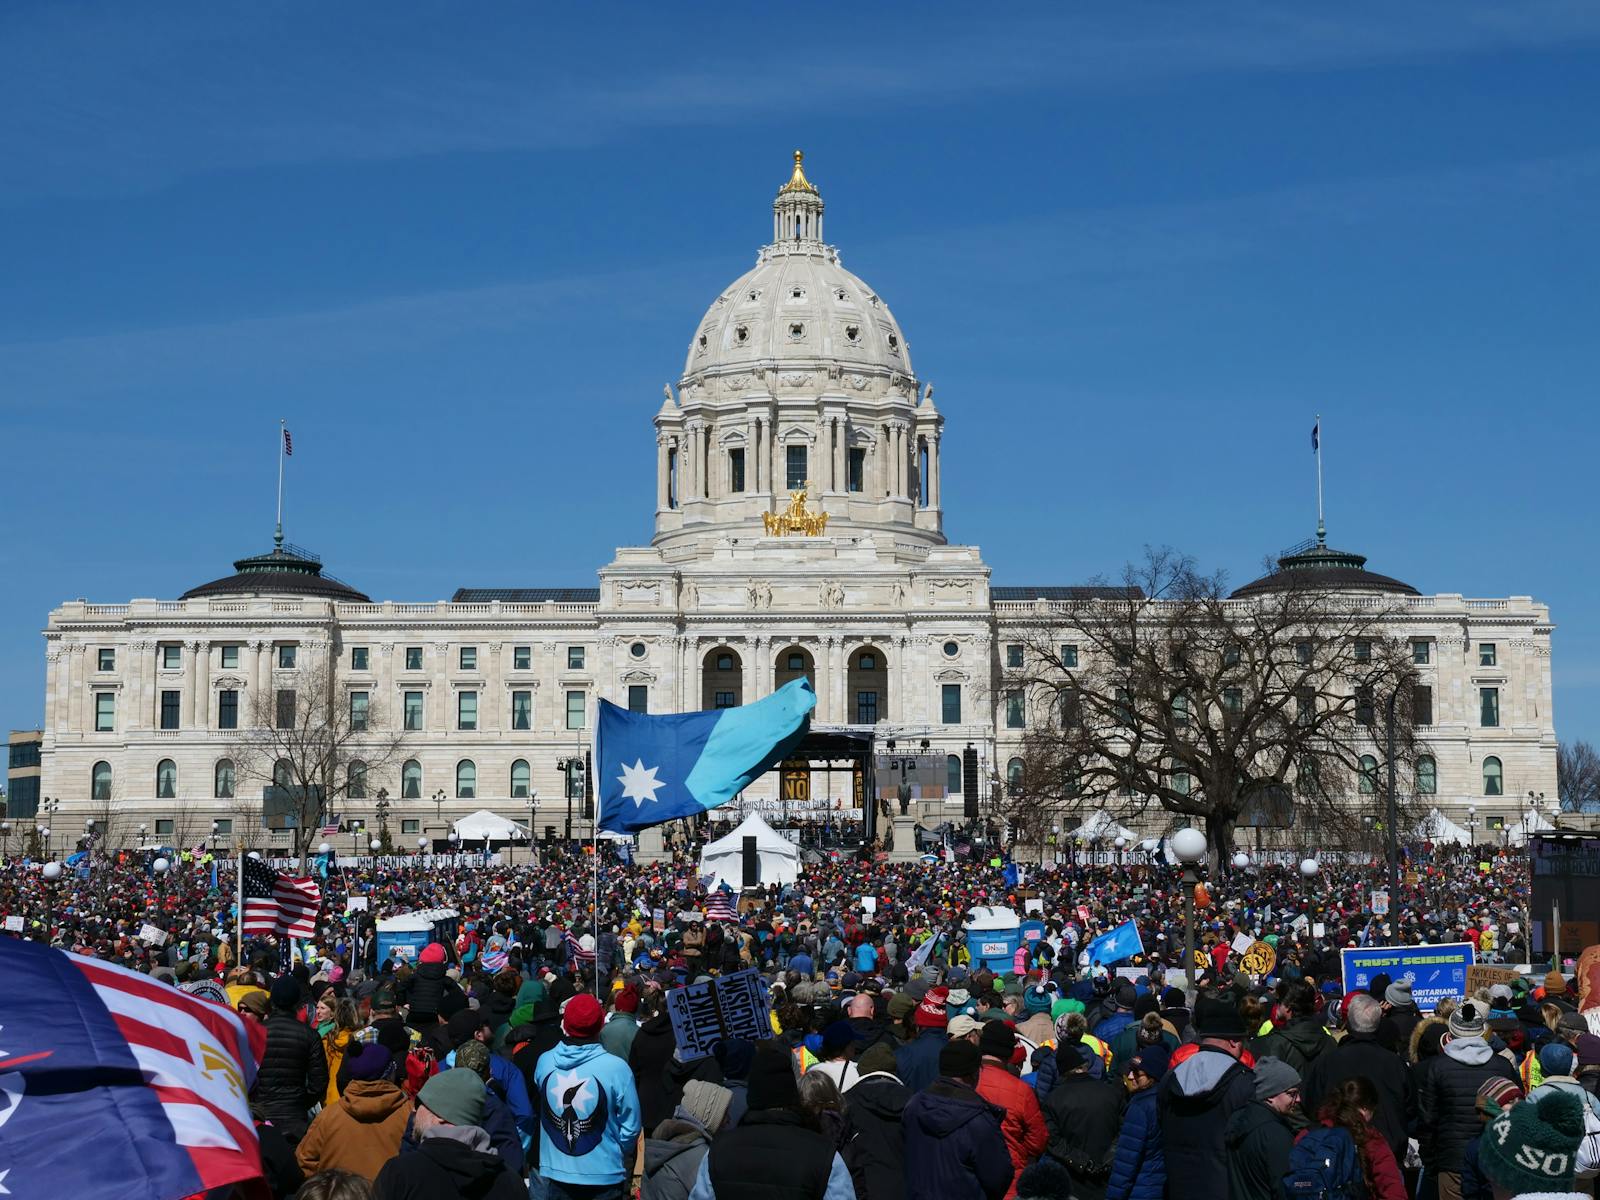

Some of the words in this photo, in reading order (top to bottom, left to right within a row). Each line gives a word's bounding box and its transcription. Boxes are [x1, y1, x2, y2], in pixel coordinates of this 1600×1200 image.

[784, 780, 807, 800] NO
[797, 801, 811, 809] HAD
[357, 856, 407, 868] IMMIGRANTS
[411, 856, 426, 868] ARE
[430, 855, 467, 867] WELCME
[1353, 958, 1400, 967] TRUST
[1402, 955, 1464, 965] SCIENCE
[1412, 988, 1458, 996] ORITARIANS
[1413, 996, 1439, 1004] TTACK
[719, 979, 735, 1040] AGAINST
[724, 976, 760, 1040] RACISM
[684, 982, 722, 1056] STRIKE
